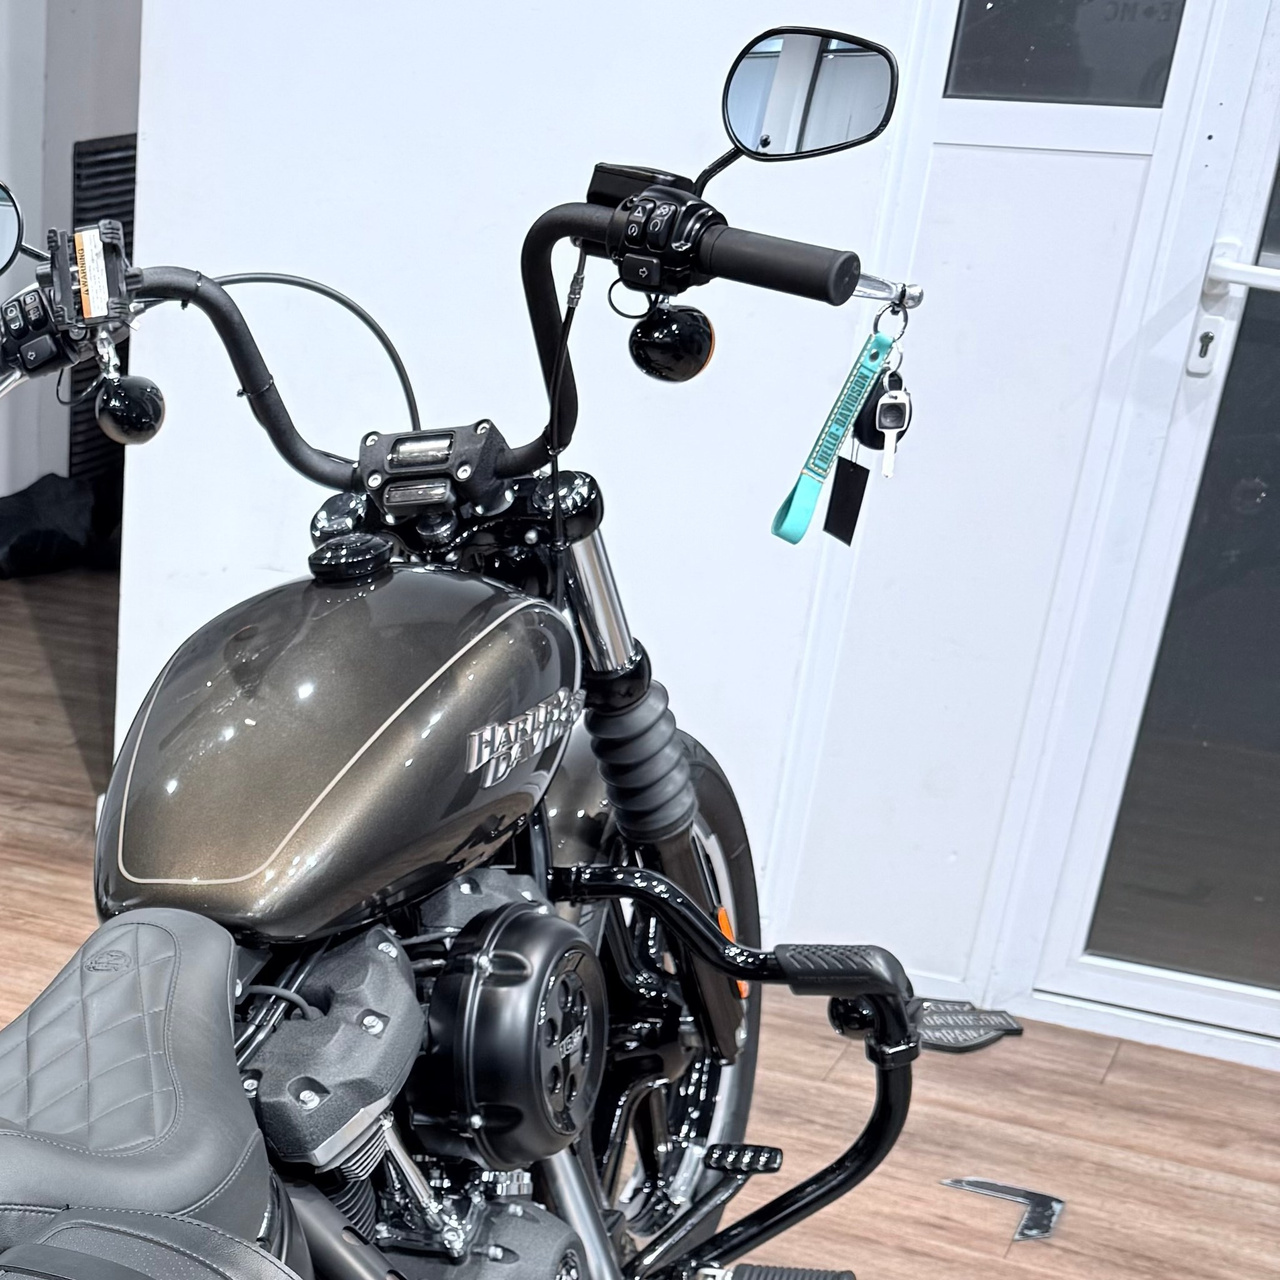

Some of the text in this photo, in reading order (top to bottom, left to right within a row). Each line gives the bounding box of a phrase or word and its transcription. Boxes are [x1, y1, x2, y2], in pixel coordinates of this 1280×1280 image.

[77, 248, 89, 289] WARNING
[817, 371, 870, 464] HELLO DAVIDSON
